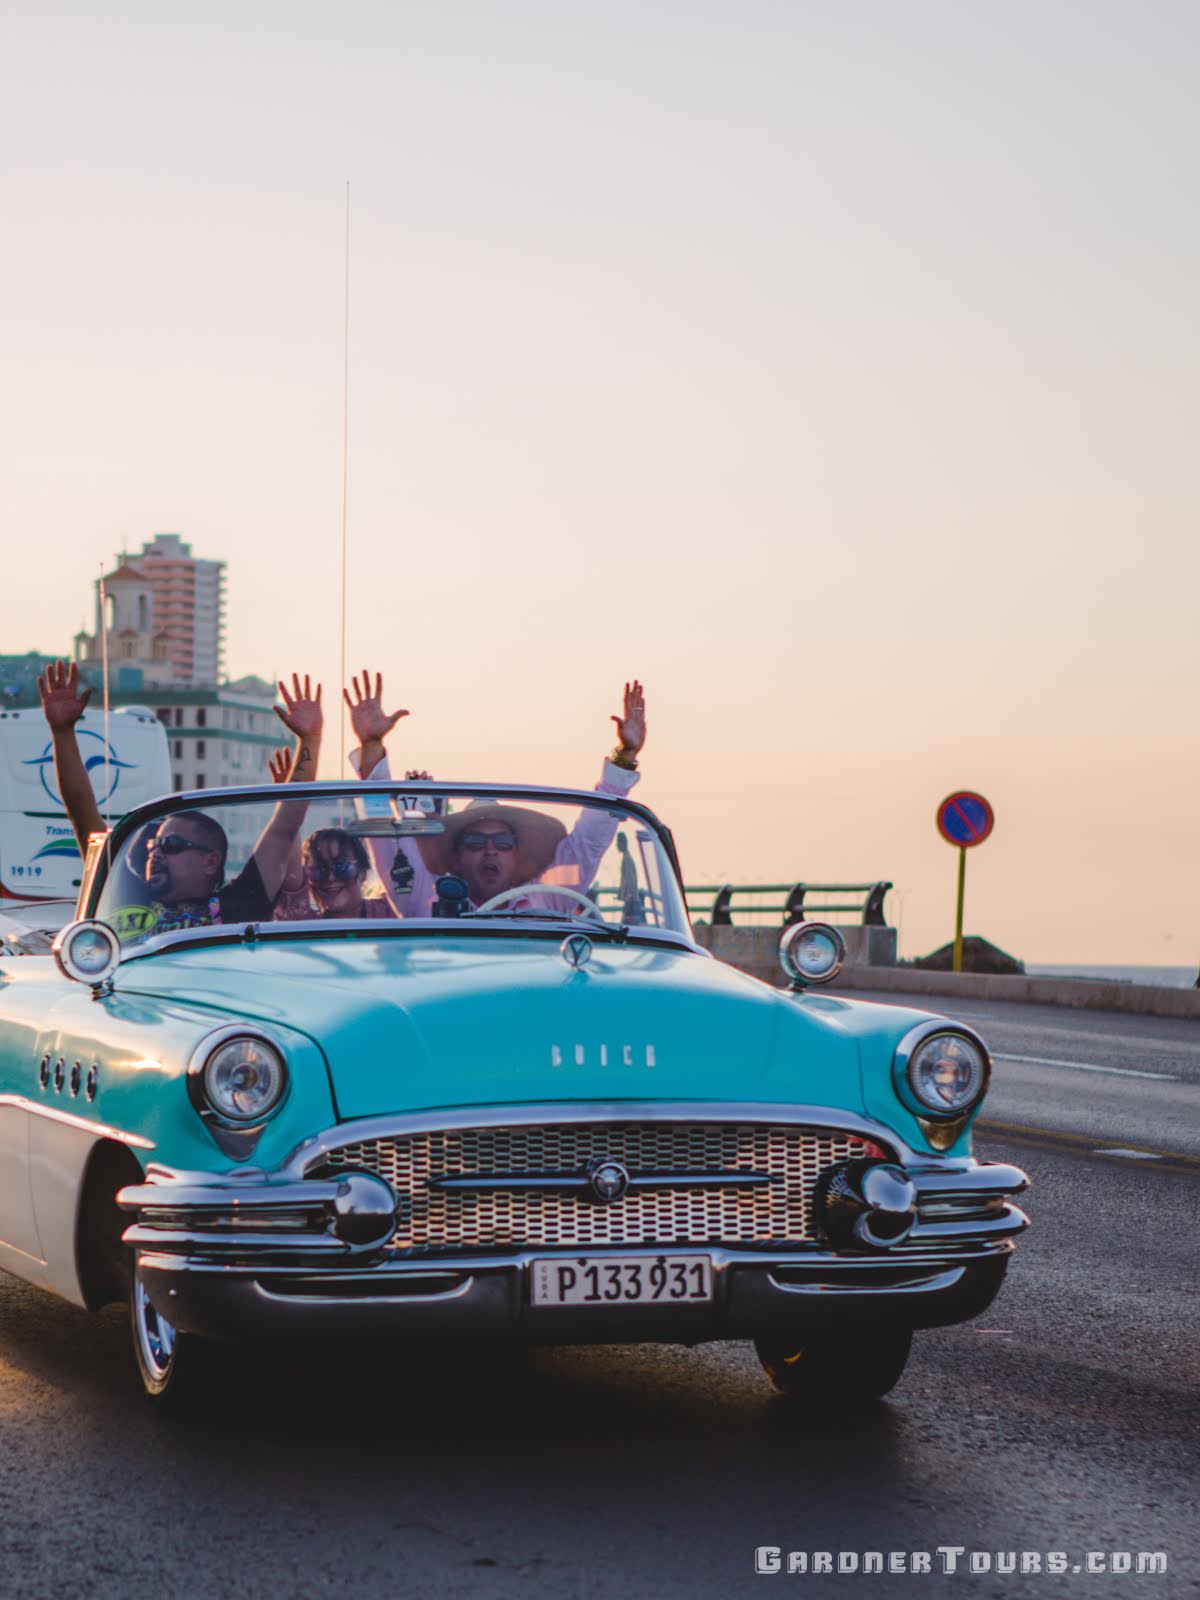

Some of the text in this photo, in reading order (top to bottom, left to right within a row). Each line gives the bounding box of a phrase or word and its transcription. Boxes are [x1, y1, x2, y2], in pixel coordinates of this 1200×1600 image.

[400, 796, 418, 811] 17
[11, 866, 42, 876] 1919
[551, 1043, 656, 1067] BUICK
